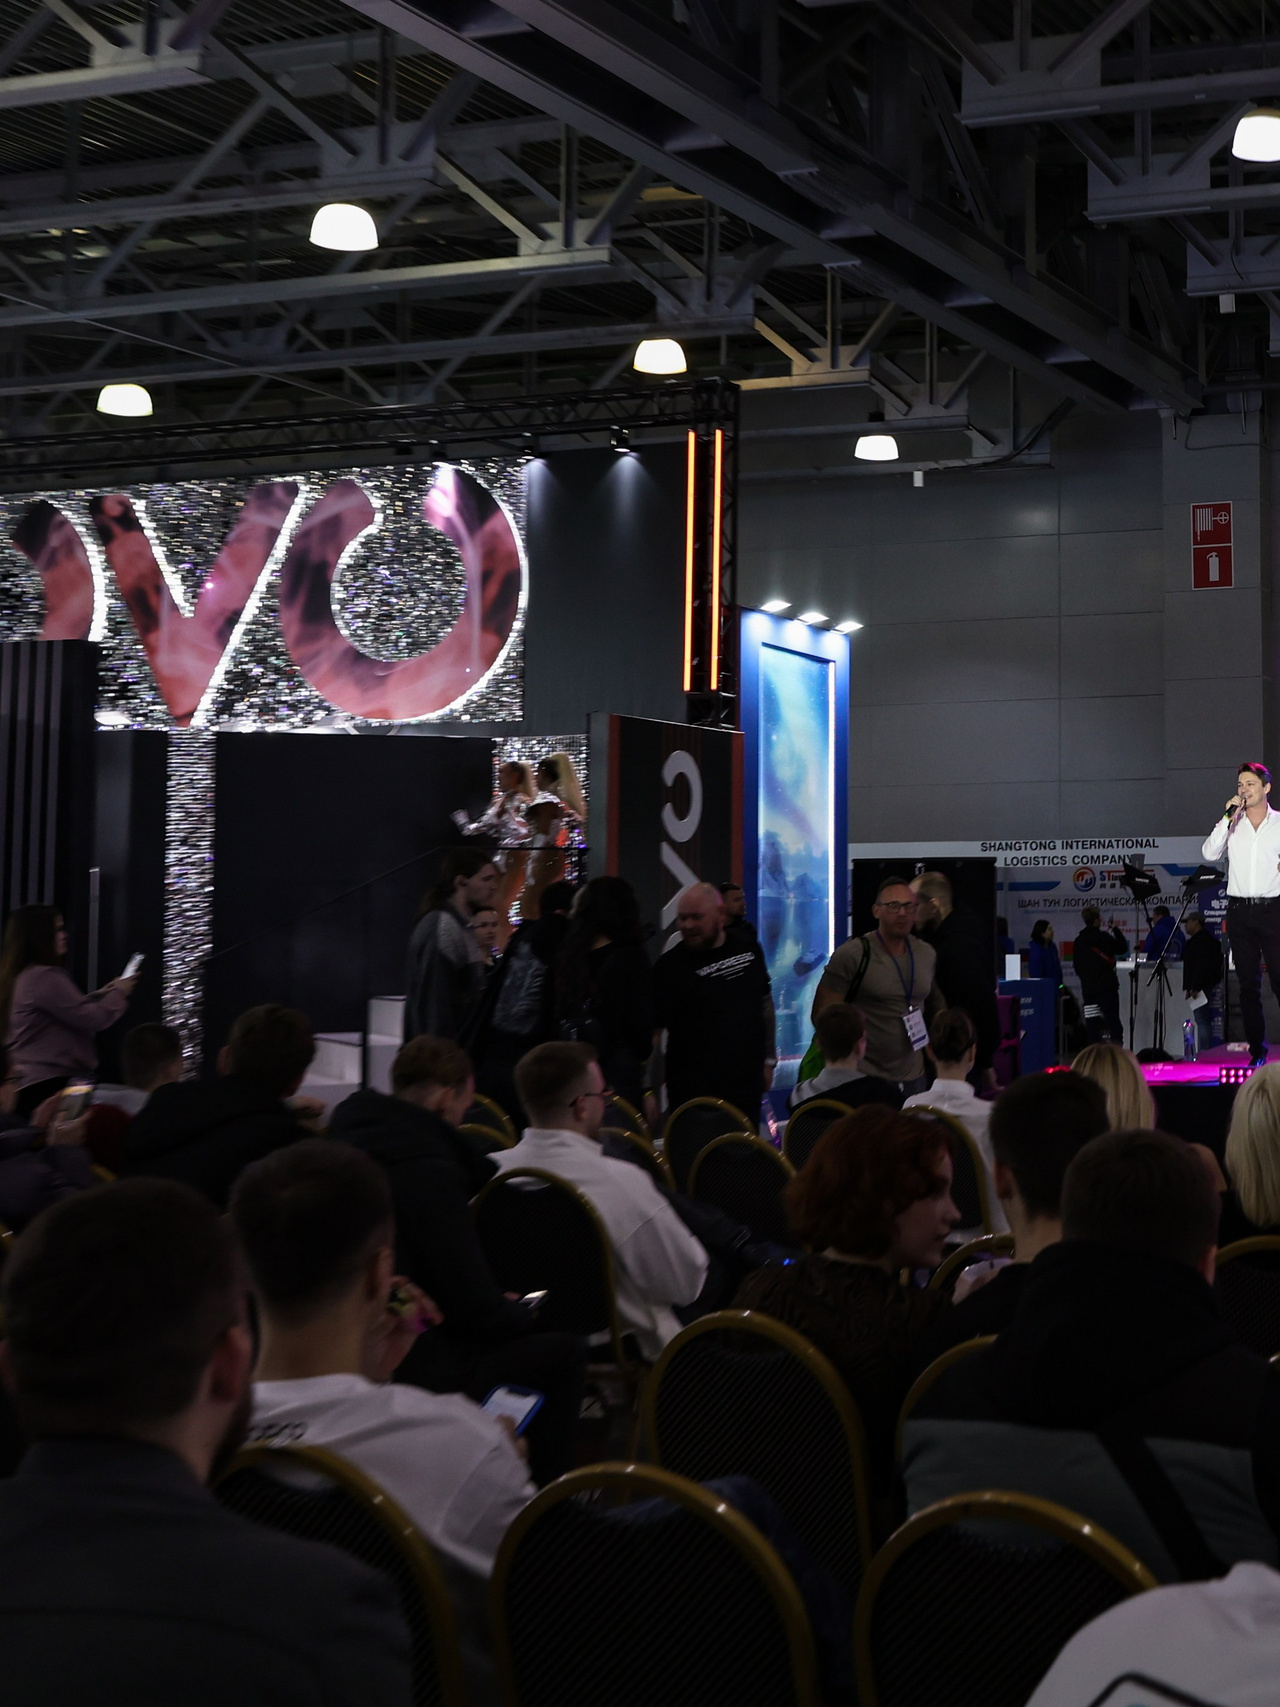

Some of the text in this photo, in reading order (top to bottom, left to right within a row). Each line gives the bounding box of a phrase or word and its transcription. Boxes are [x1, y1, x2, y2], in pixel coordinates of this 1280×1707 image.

[981, 838, 1159, 852] SHANGTONG INTERNATIONAL
[1004, 854, 1132, 867] LOGISTICS COMPANY
[1018, 896, 1040, 908] ШАН
[1043, 896, 1062, 909] ТУН
[1063, 895, 1146, 908] ЛОГИСТИЧЕСКА
